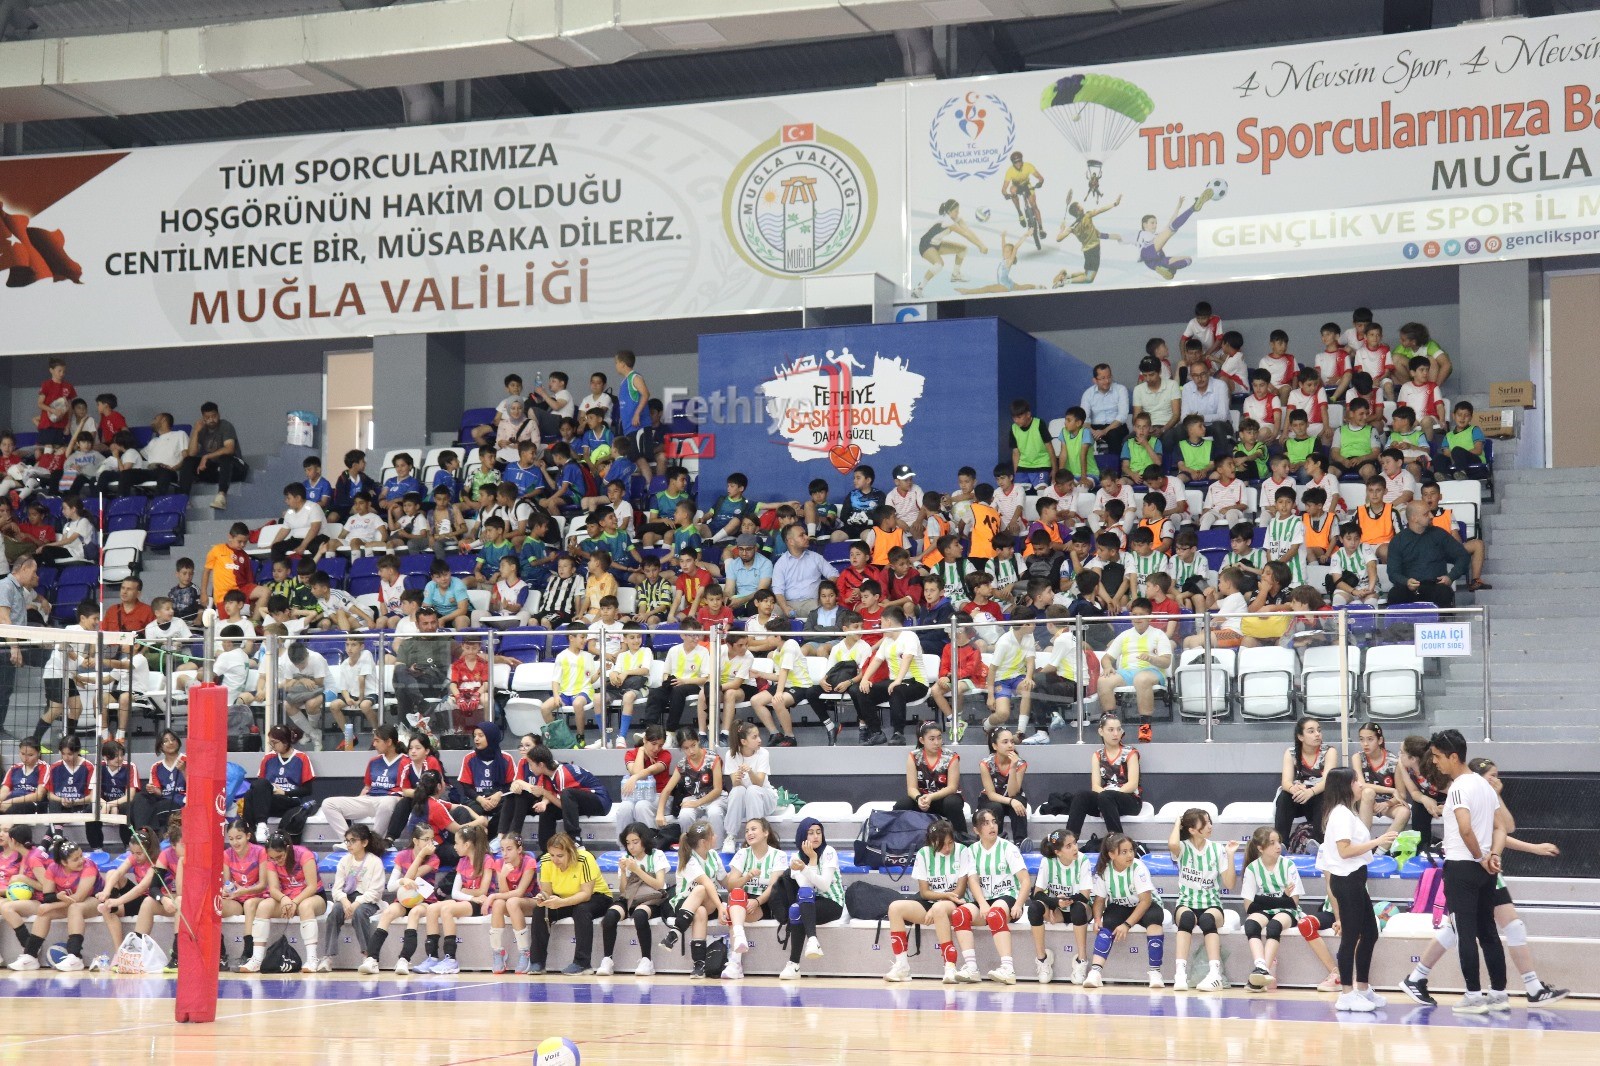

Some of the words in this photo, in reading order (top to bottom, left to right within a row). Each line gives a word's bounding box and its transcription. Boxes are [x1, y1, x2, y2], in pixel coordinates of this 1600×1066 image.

[1234, 70, 1260, 98] 4
[1265, 60, 1375, 98] Mevsim
[1382, 50, 1451, 94] Spor,
[1459, 46, 1490, 75] 4
[1138, 123, 1225, 171] Tüm
[1236, 98, 1550, 176] Sporcularımıza
[219, 158, 285, 190] TÜM
[294, 142, 558, 188] SPORCULARIMIZA
[743, 157, 784, 215] MUĞLA
[796, 151, 859, 208] VALİLİĞİ
[1431, 143, 1592, 191] MUĞLA
[160, 192, 372, 237] HOŞGÖRÜNÜN
[382, 185, 483, 219] HAKİM
[493, 173, 622, 212] OLDUĞU
[1211, 210, 1362, 248] GENÇLİK
[1370, 207, 1416, 235] VE
[1426, 201, 1524, 231] SPOR
[1535, 193, 1567, 221] İL
[104, 241, 303, 277] CENTİLMENCE
[313, 236, 366, 265] BİR,
[377, 225, 548, 260] MÜSABAKA
[559, 211, 683, 248] DİLERİZ.
[786, 245, 812, 269] MUĞLA
[189, 277, 366, 325] MUĞLA
[380, 257, 590, 315] VALİLİĞİ
[813, 382, 876, 407] FETHİYE
[786, 402, 904, 434] BASKETBOLLA
[812, 430, 843, 444] DAHA
[845, 428, 876, 442] GÜZEL
[1421, 630, 1447, 640] SAHA
[1449, 627, 1464, 641] İÇİ
[1447, 642, 1465, 650] SIDE)
[375, 775, 389, 783] ATA
[484, 768, 491, 778] 8
[241, 873, 249, 885] 9
